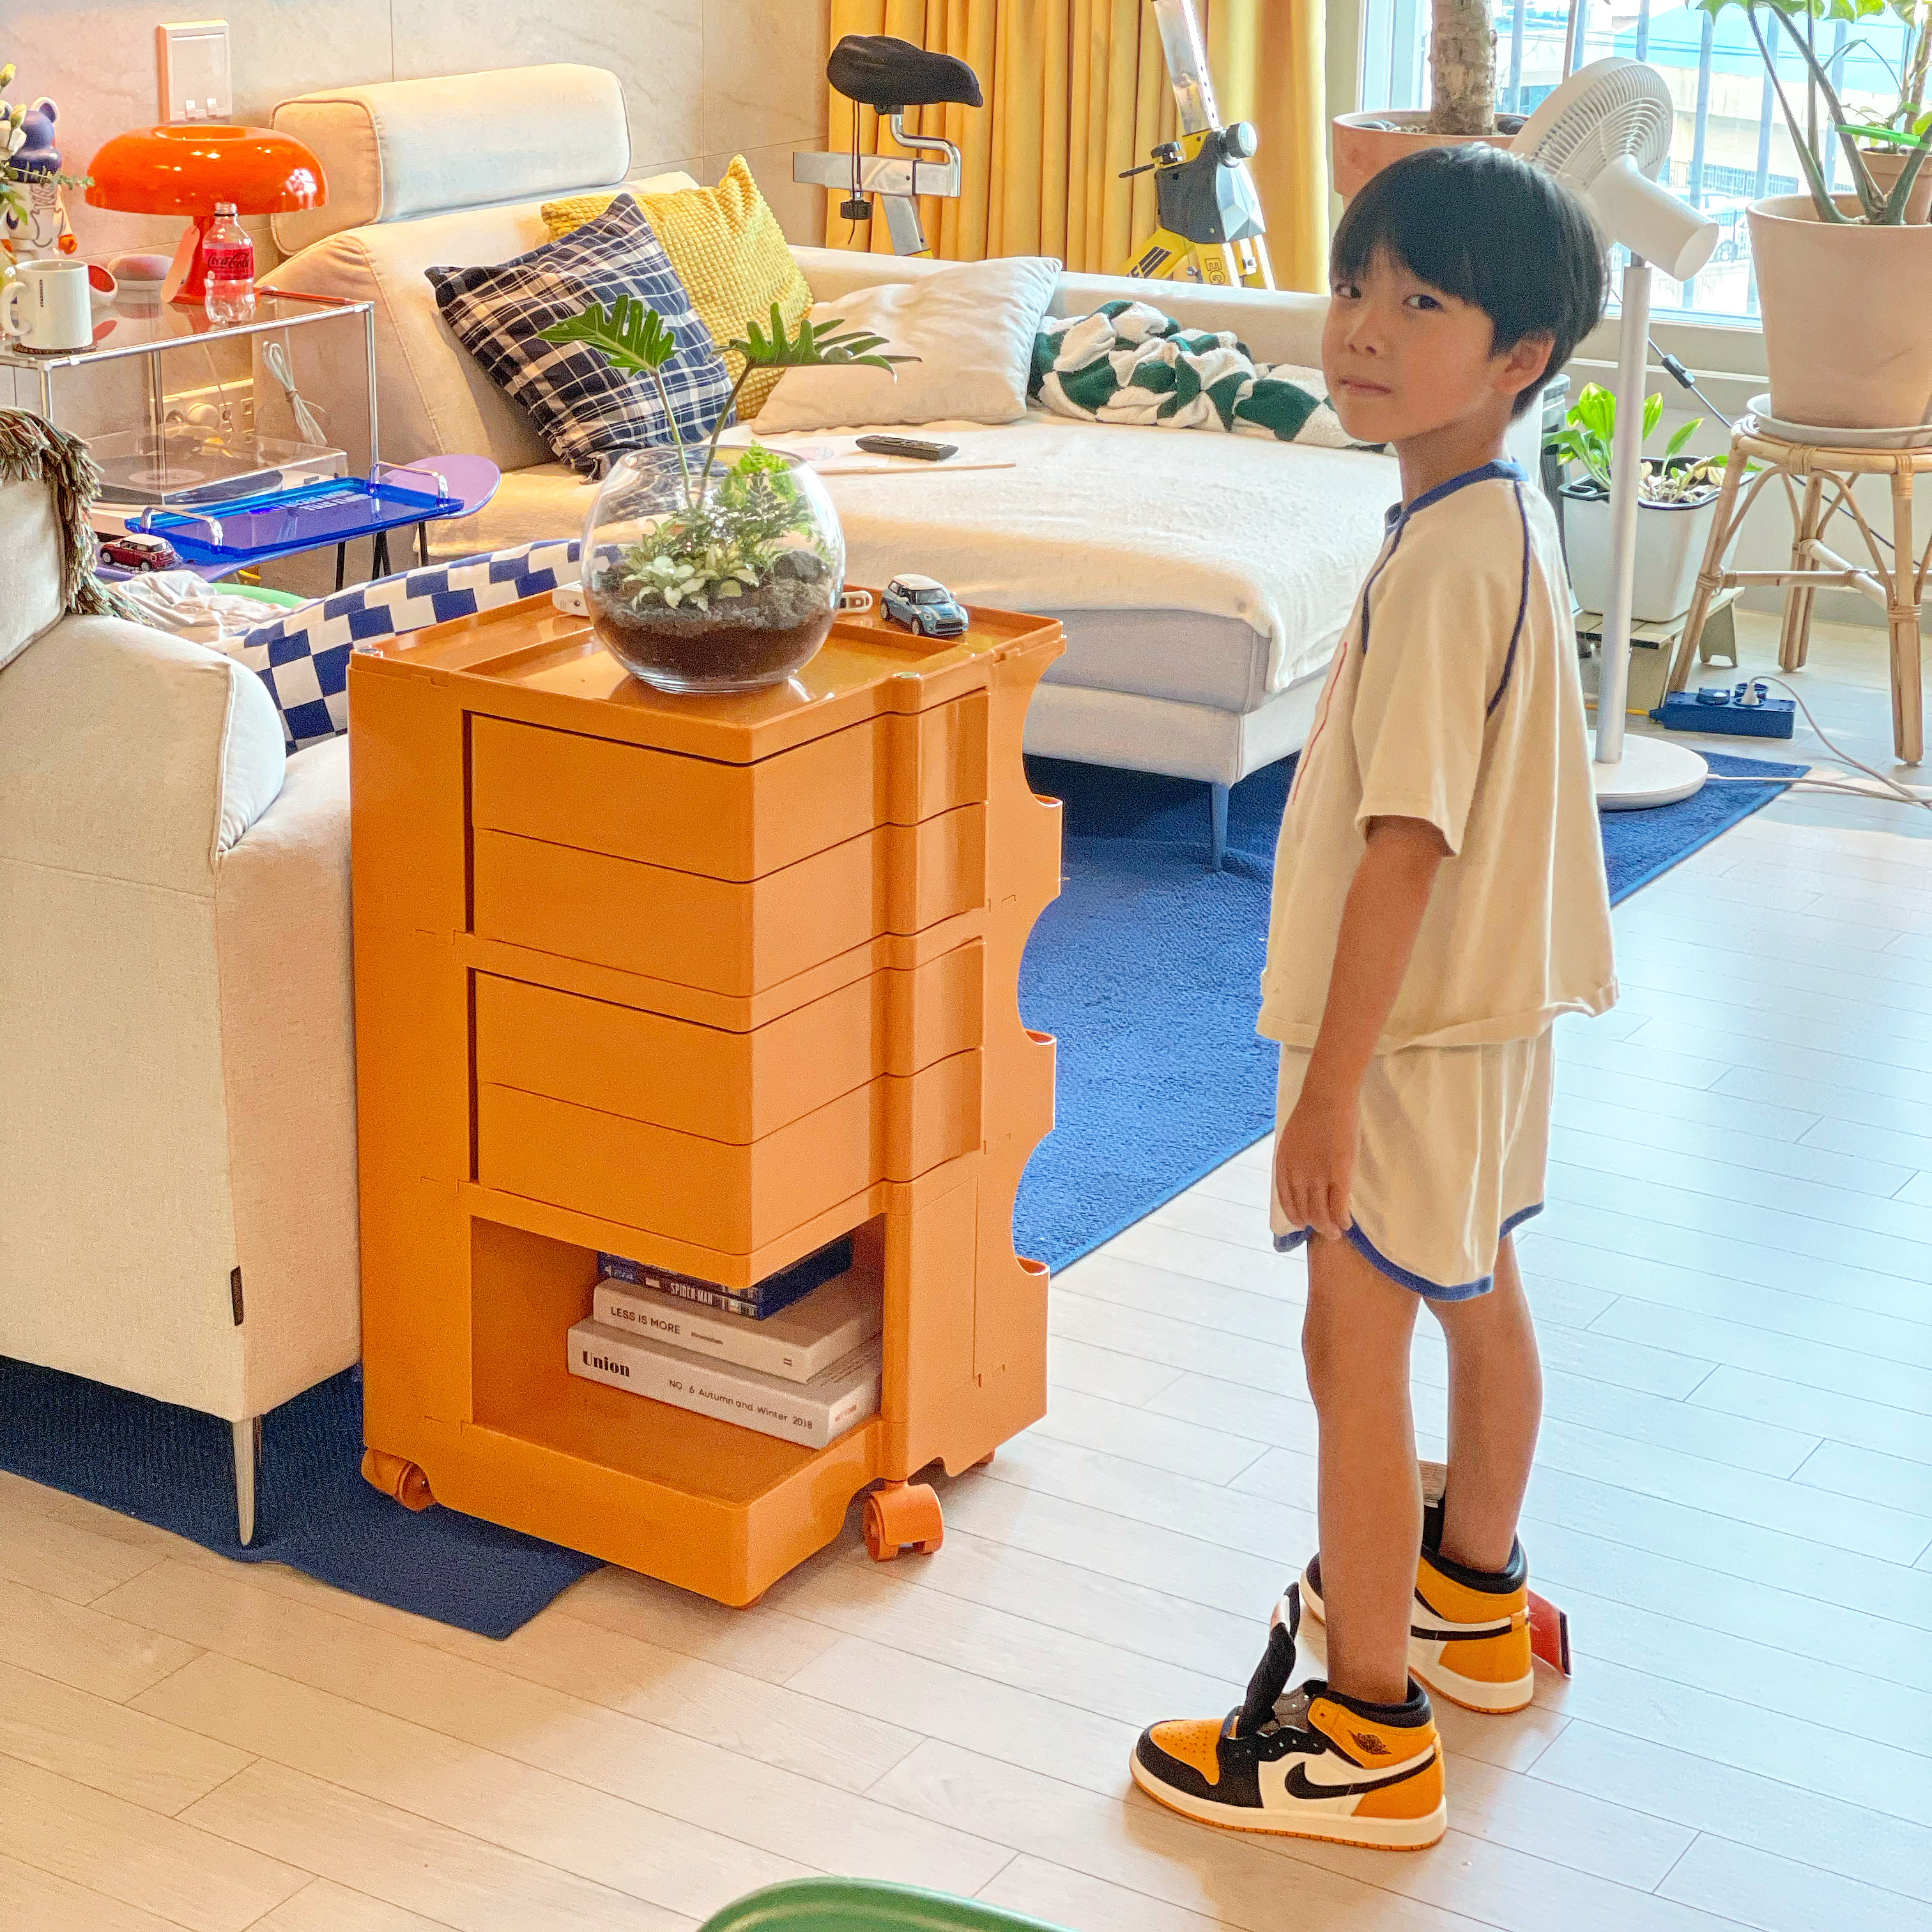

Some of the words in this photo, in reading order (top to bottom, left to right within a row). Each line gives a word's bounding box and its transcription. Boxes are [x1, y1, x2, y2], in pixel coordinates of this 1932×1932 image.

[611, 1306, 636, 1321] LESS
[638, 1314, 647, 1324] IS
[650, 1317, 681, 1335] MORE
[583, 1351, 630, 1377] Union
[689, 1385, 694, 1393] 6
[699, 1388, 733, 1405] Autumn
[735, 1400, 753, 1411] and
[757, 1406, 788, 1422] Winter
[792, 1416, 813, 1430] 2018
